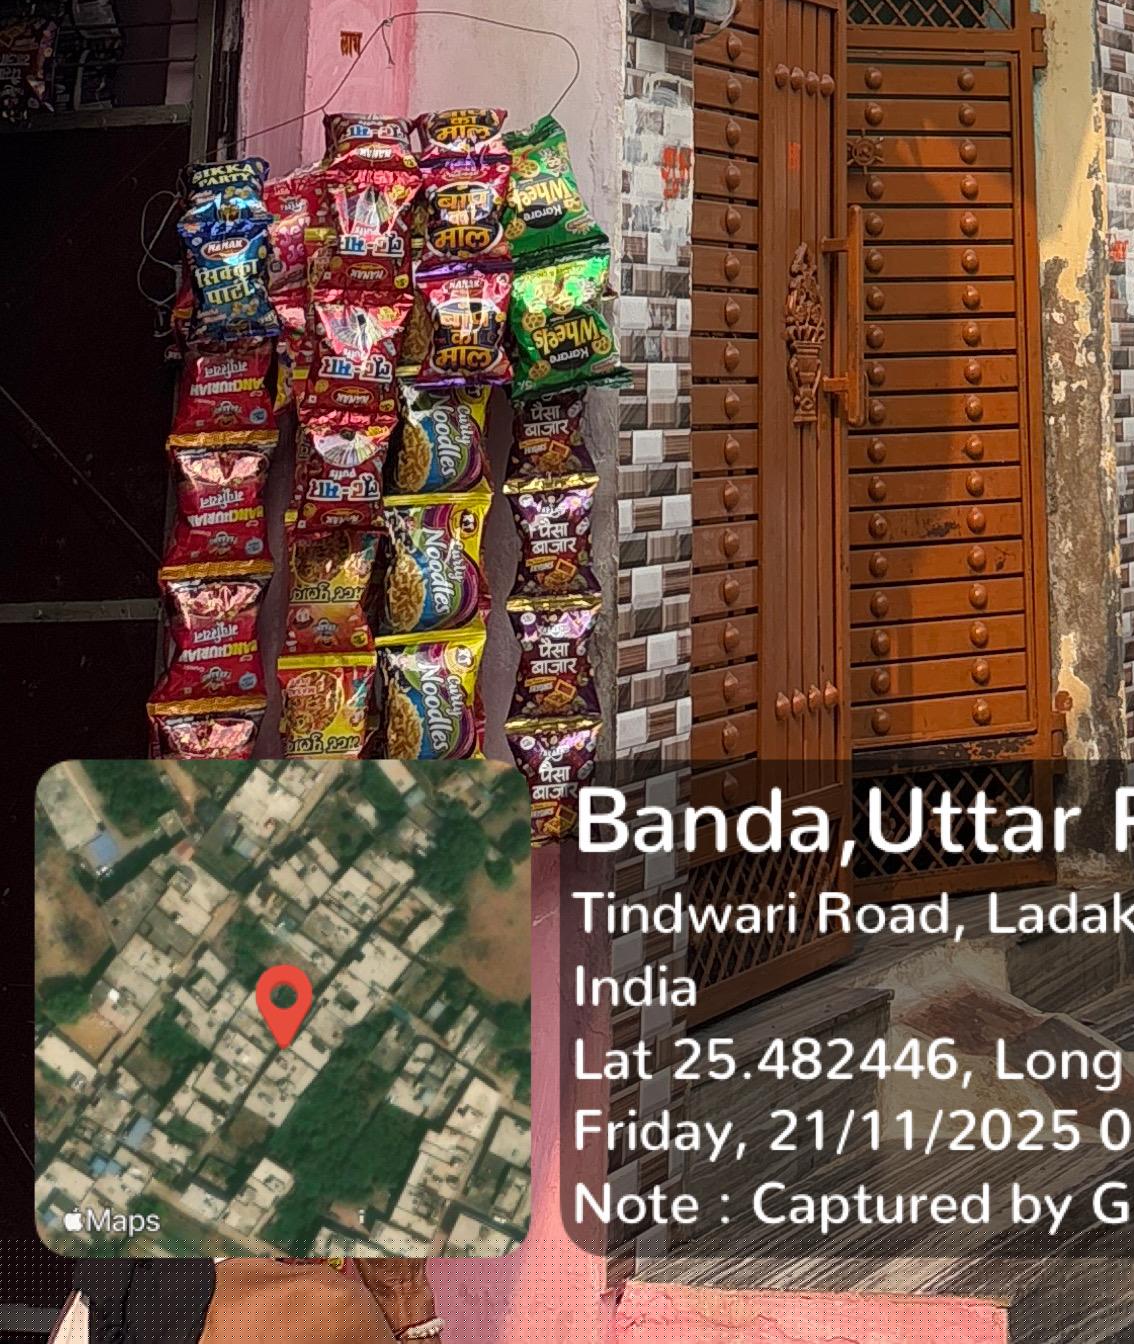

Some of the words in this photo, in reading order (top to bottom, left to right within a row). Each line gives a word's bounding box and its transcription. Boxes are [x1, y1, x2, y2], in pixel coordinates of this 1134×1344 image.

[434, 226, 491, 249] माल
[532, 316, 601, 355] Wheels
[435, 345, 492, 368] माल
[549, 346, 589, 364] Karare
[190, 377, 265, 397] ANCHURIAN
[429, 393, 462, 477] Noodles
[455, 405, 474, 444] Curly
[306, 472, 381, 502] लूट-मार
[422, 527, 456, 614] Noodles
[538, 636, 570, 659] पैसा
[418, 663, 453, 751] Noodles
[446, 675, 464, 716] Curly
[538, 759, 571, 783] पैसा
